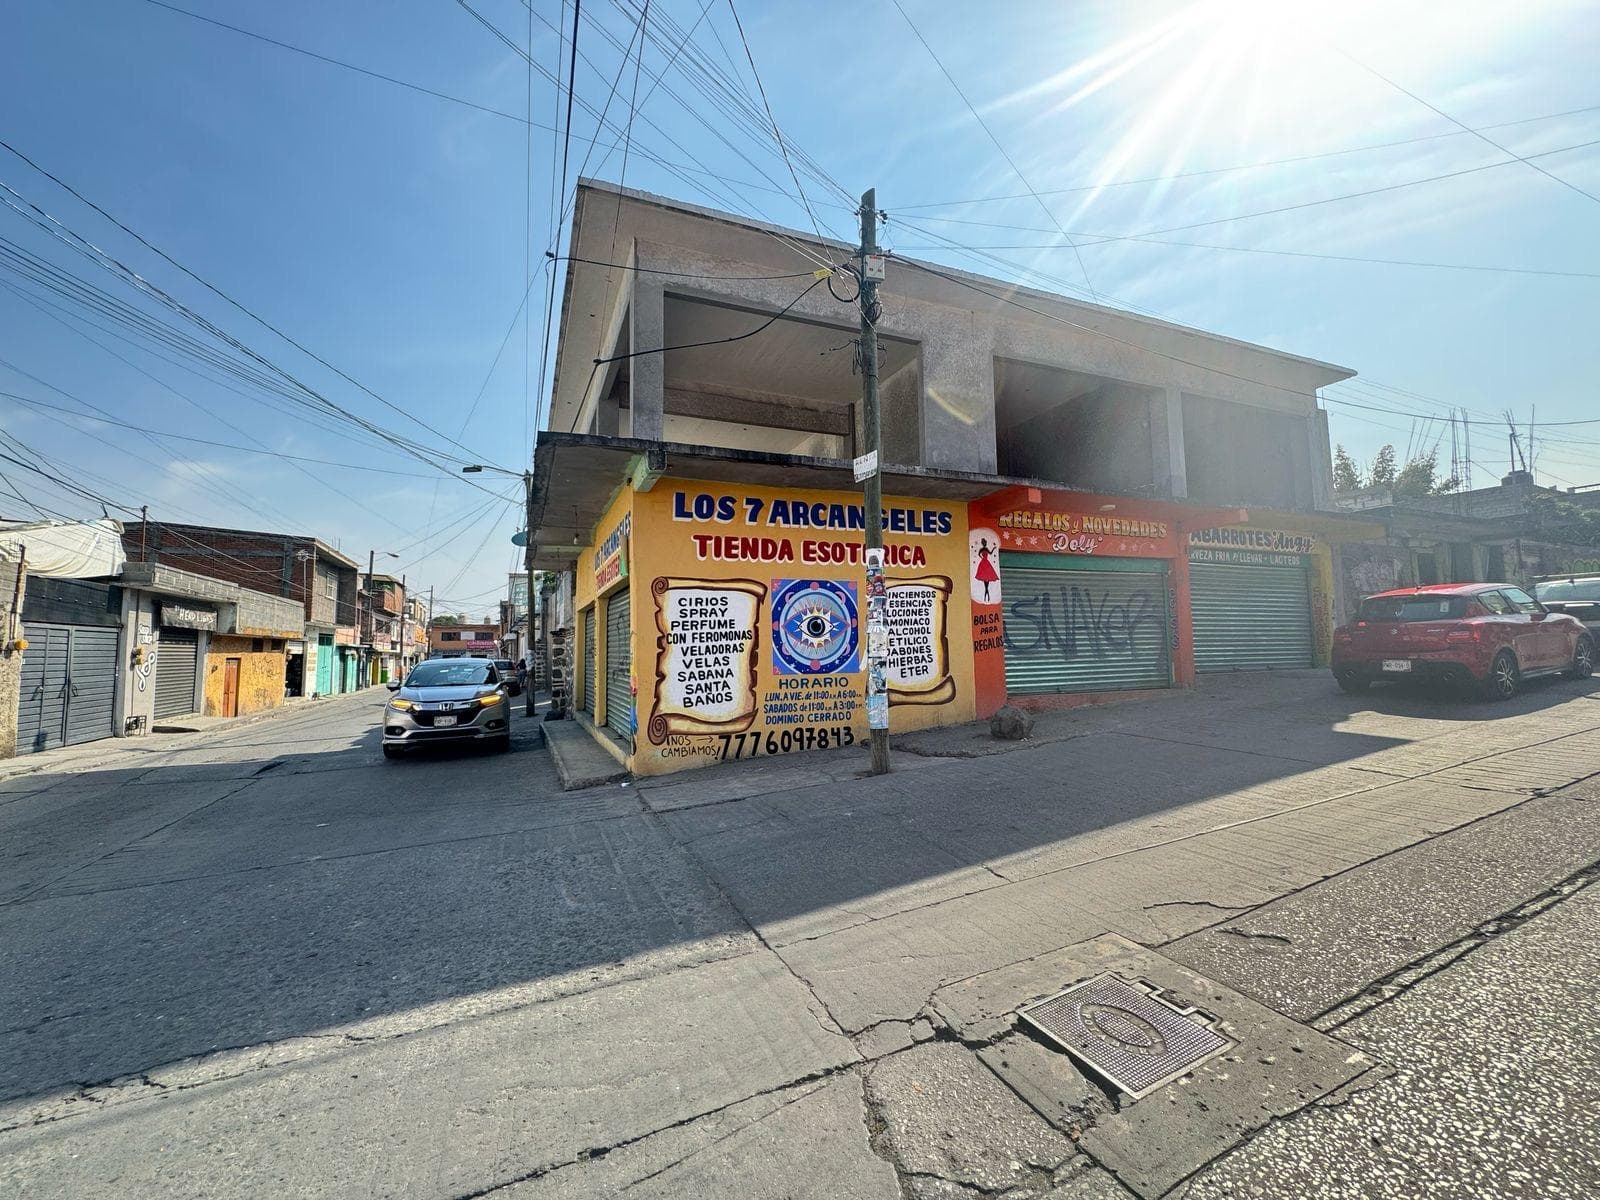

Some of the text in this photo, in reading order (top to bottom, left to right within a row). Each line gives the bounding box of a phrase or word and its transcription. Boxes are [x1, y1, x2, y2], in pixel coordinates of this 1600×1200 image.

[673, 491, 737, 524] LOS
[743, 496, 765, 526] 7
[999, 510, 1168, 538] REGALOS y NOVEDADES
[1190, 528, 1273, 549] ABARROTES
[691, 534, 926, 569] TIENDA ESOTRICA
[677, 596, 729, 607] CIRIOS
[888, 591, 937, 599] INCIENSOS
[889, 599, 932, 608] ESENCIAS
[679, 607, 728, 618] SPRAY
[886, 608, 930, 617] LOCIONES
[671, 619, 736, 631] PERFUME
[973, 613, 1000, 626] BOLSA
[888, 627, 931, 636] ALCOHOL
[980, 625, 998, 635] PARA
[666, 630, 753, 645] CON FEROMONAS
[889, 636, 928, 647] ETILICO
[681, 643, 745, 657] VELADORAS
[973, 636, 1004, 653] REGALOS
[682, 656, 730, 669] VELAS
[888, 654, 933, 668] HIERBAS
[677, 668, 734, 682] SABANA
[900, 665, 929, 678] ETER
[685, 680, 731, 695] SANTA
[778, 676, 849, 689] HORARIO
[683, 691, 733, 708] BAÑOS
[813, 690, 829, 700] 11:00
[842, 689, 857, 699] 6:00
[763, 703, 798, 714] SABADOS
[799, 703, 808, 712] de
[808, 702, 825, 711] 11:00
[839, 700, 856, 710] 3:00
[765, 711, 852, 725] DOMINGO CERRADO
[718, 726, 855, 760] 7776097843
